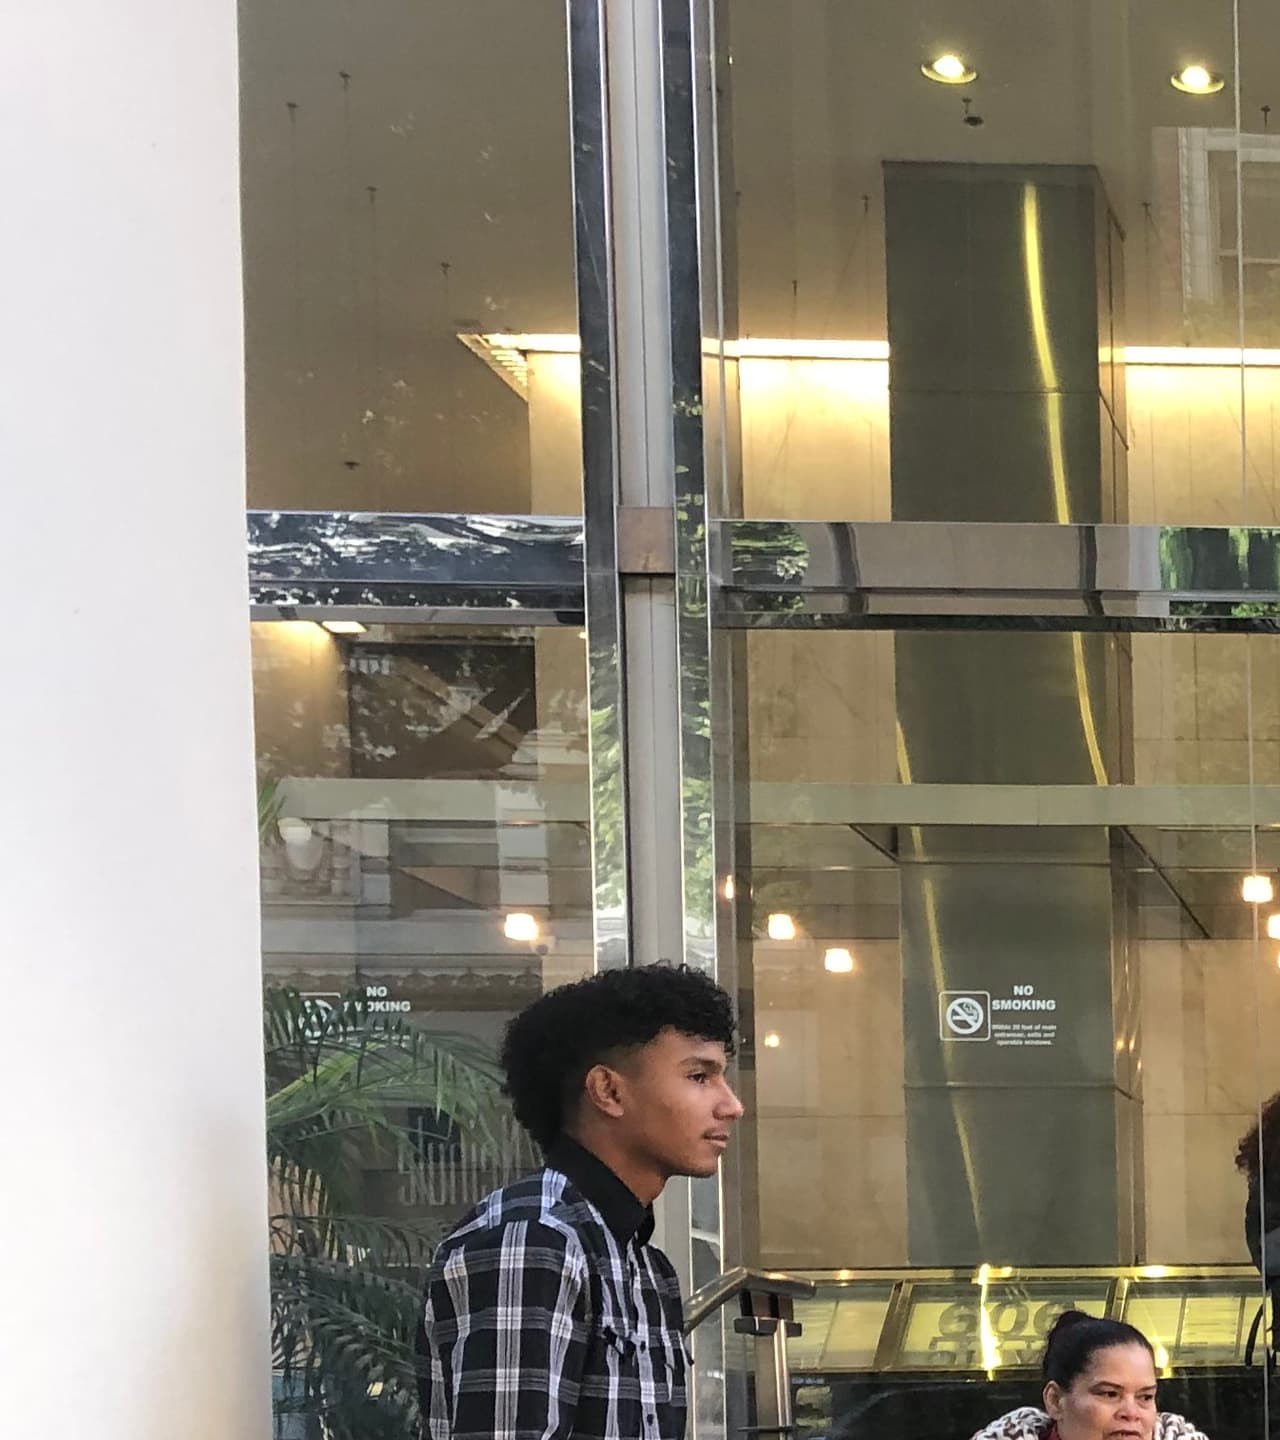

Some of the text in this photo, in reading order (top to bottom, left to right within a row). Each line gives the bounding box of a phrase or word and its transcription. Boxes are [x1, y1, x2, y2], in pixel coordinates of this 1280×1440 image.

[366, 986, 388, 997] NO
[1013, 985, 1034, 996] NO
[992, 999, 1056, 1011] SMOKING
